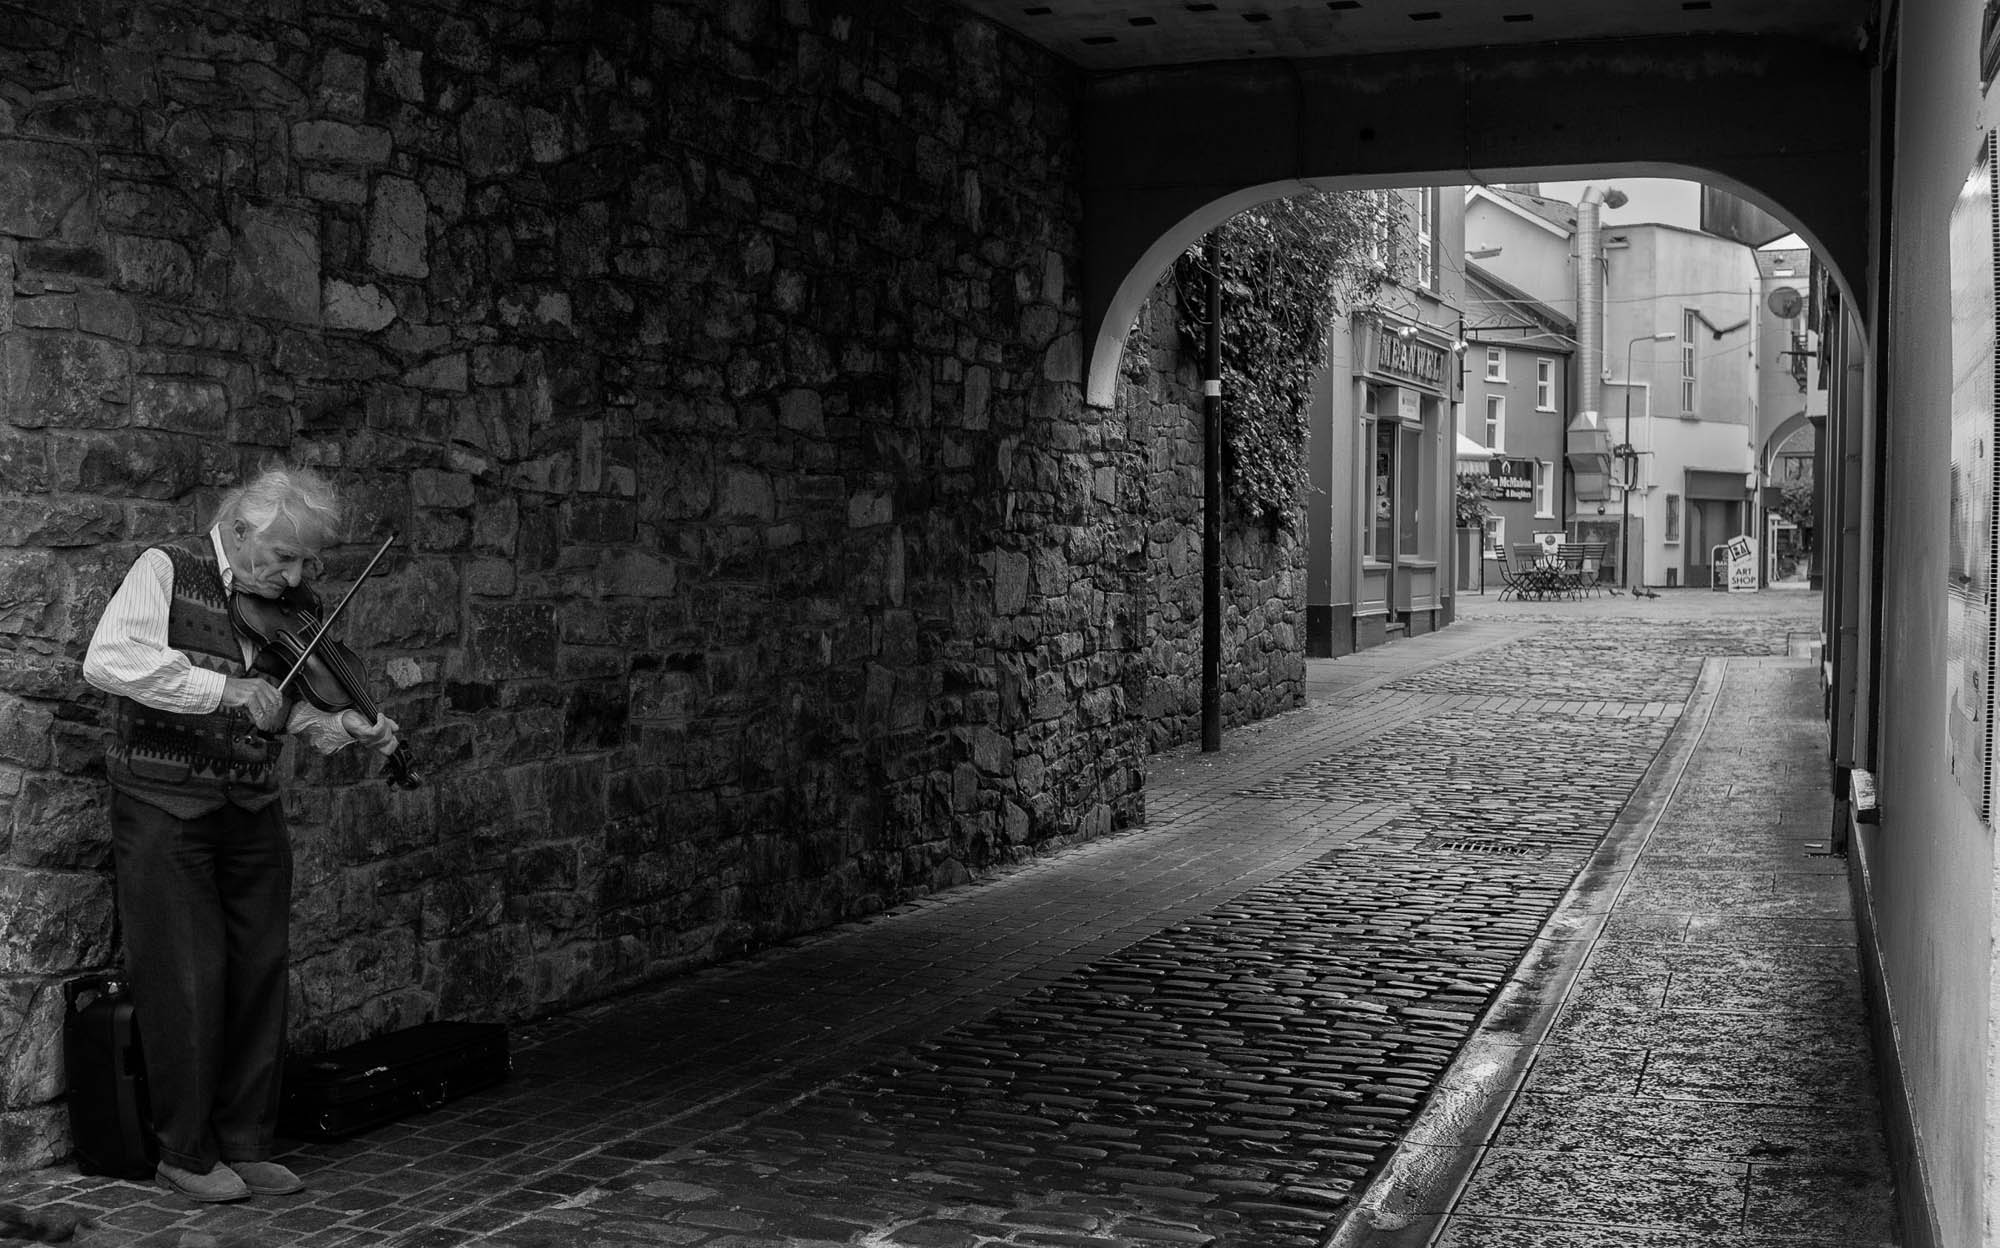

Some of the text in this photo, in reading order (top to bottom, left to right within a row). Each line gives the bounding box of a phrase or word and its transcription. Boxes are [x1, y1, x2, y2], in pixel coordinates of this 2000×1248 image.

[1499, 476, 1531, 488] McMahon
[1735, 568, 1752, 576] ART
[1731, 576, 1756, 585] SHOP
